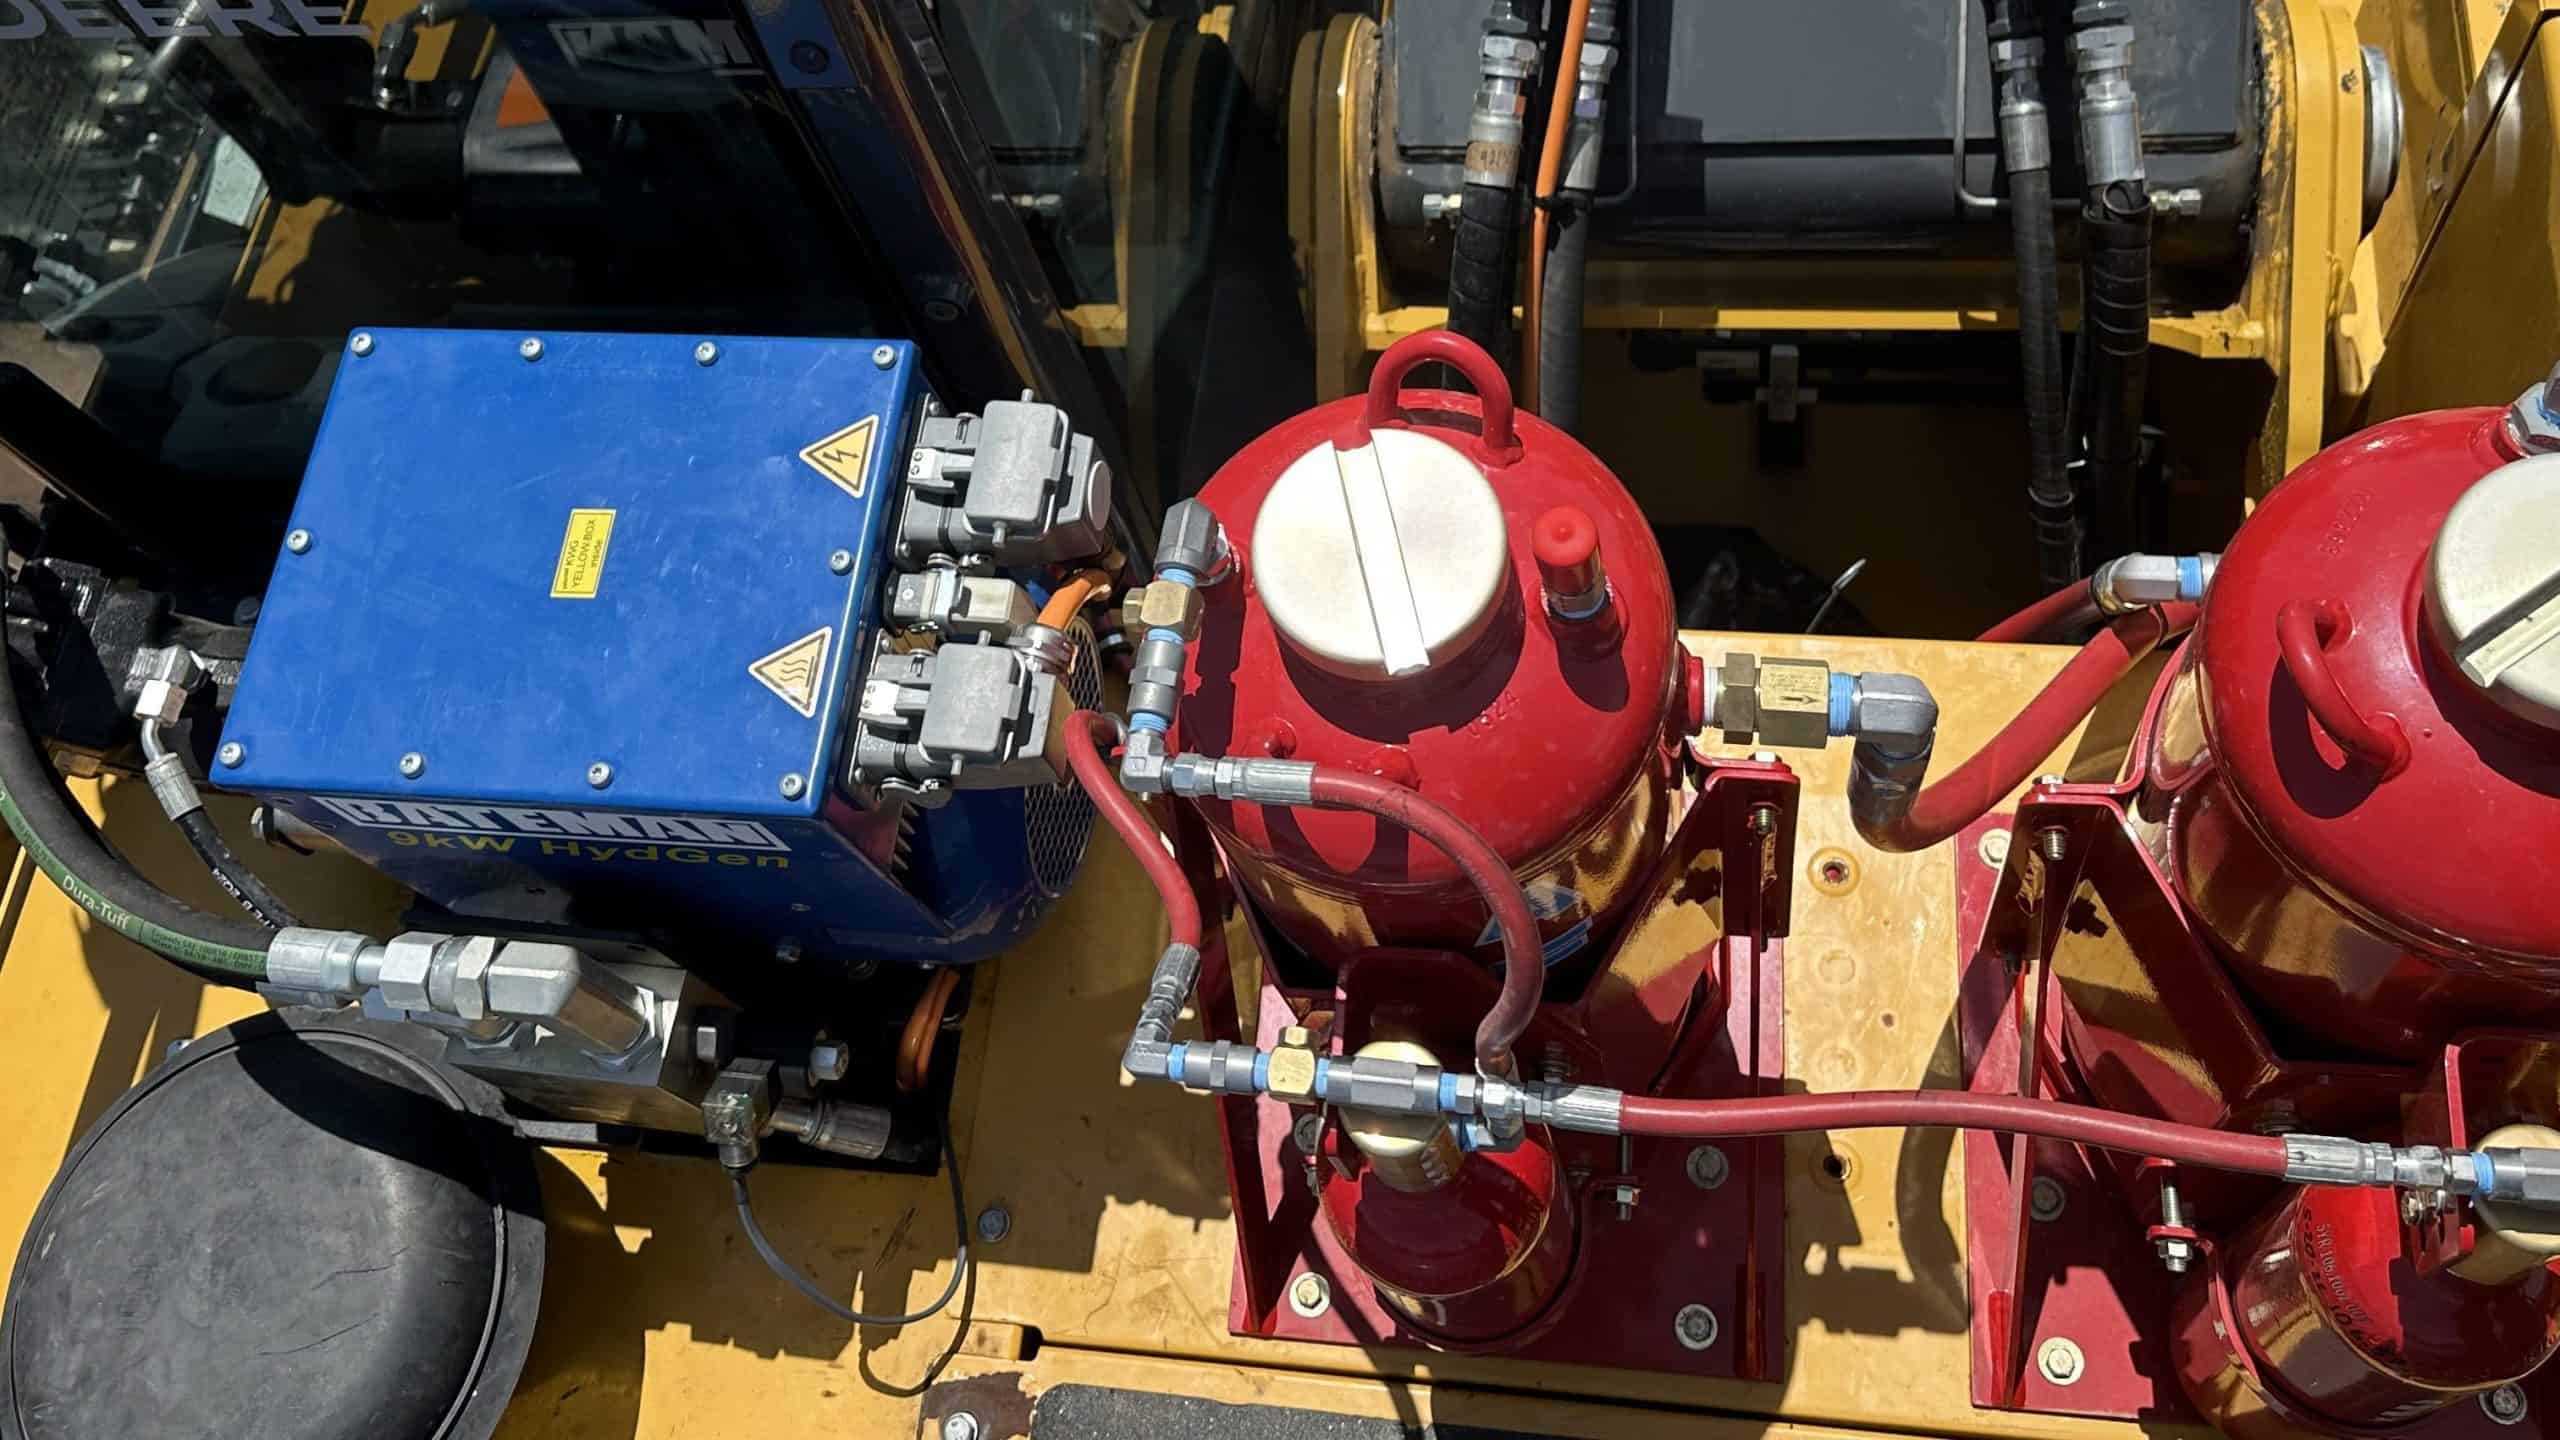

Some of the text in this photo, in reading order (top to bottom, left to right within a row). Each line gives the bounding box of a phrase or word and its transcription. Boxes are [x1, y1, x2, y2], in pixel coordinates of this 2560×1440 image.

[322, 797, 780, 848] BATEMAN
[386, 830, 789, 869] 9kW HydGen
[61, 874, 130, 930] Dura-Tuff
